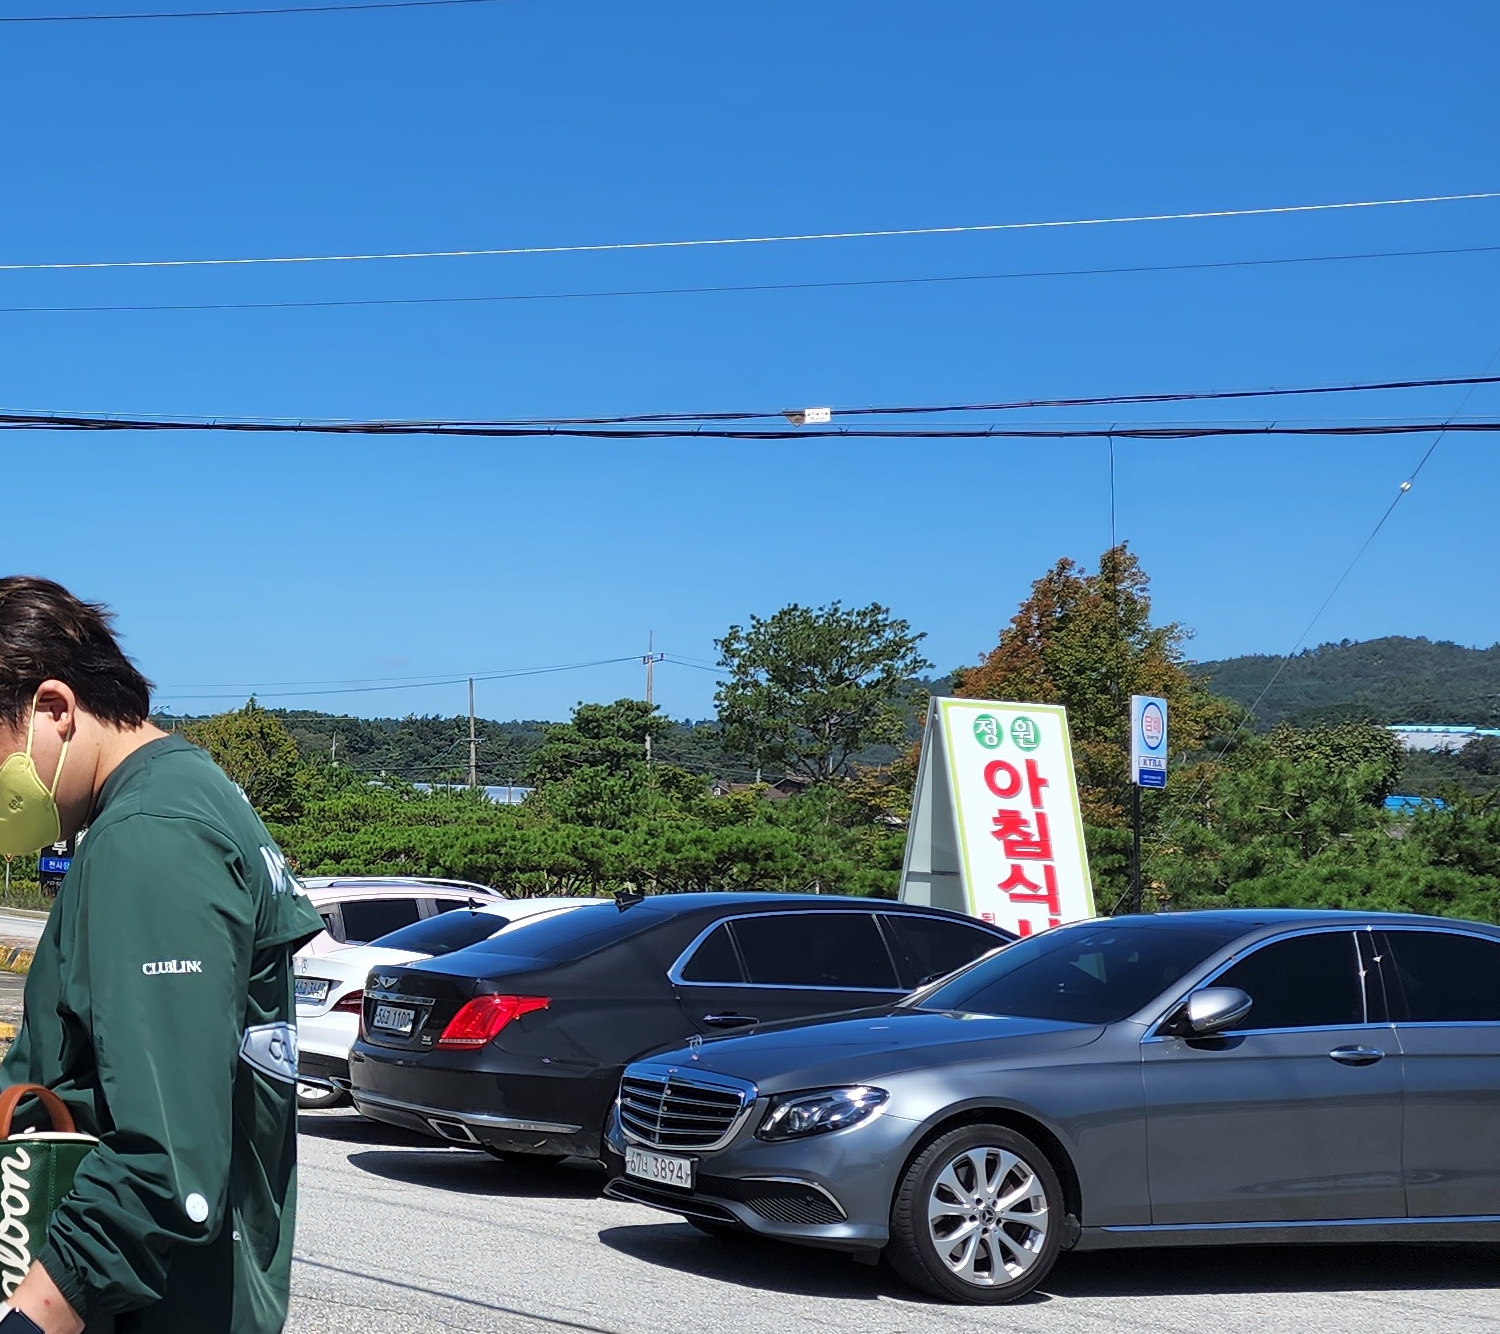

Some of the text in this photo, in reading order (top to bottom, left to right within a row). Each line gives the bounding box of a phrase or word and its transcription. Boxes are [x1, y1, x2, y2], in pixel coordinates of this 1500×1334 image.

[975, 717, 1038, 749] 정원
[983, 758, 1062, 938] 아침식
[652, 1156, 685, 1184] 3894
